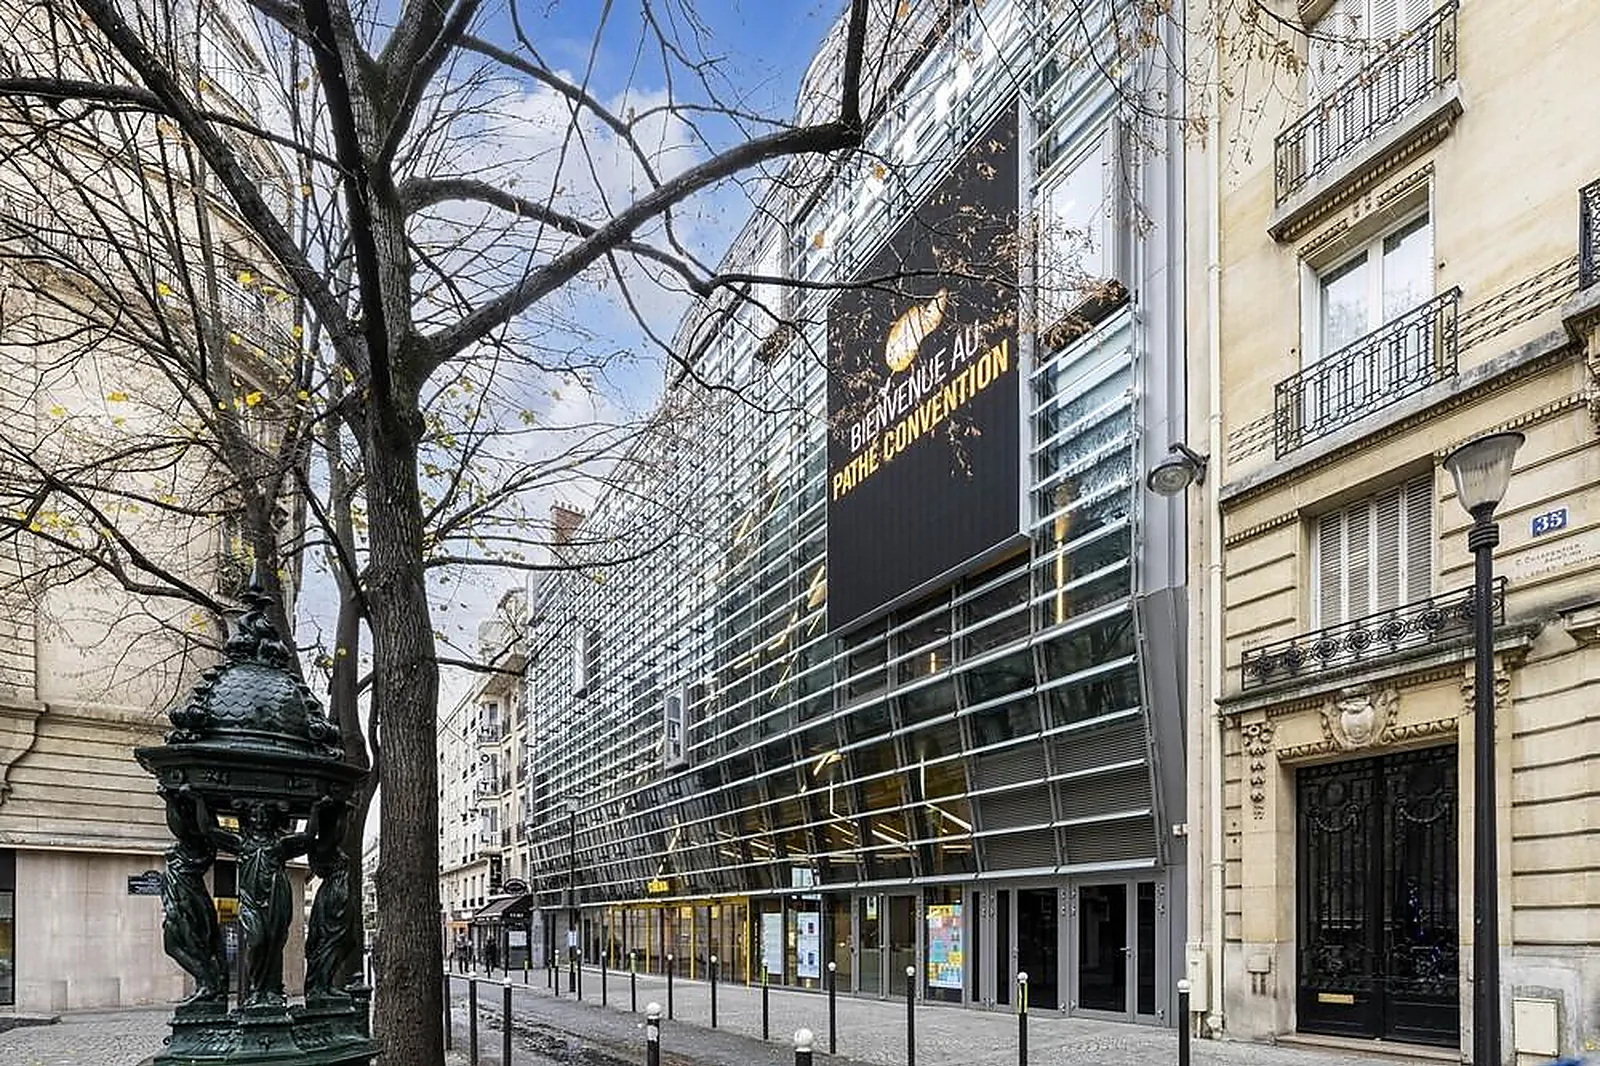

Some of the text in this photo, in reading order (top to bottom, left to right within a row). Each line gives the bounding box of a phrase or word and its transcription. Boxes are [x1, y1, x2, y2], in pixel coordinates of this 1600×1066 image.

[833, 338, 1009, 502] PATHÉ CONVENTION
[850, 318, 981, 453] BIENVENUE AU
[1537, 511, 1562, 531] 35
